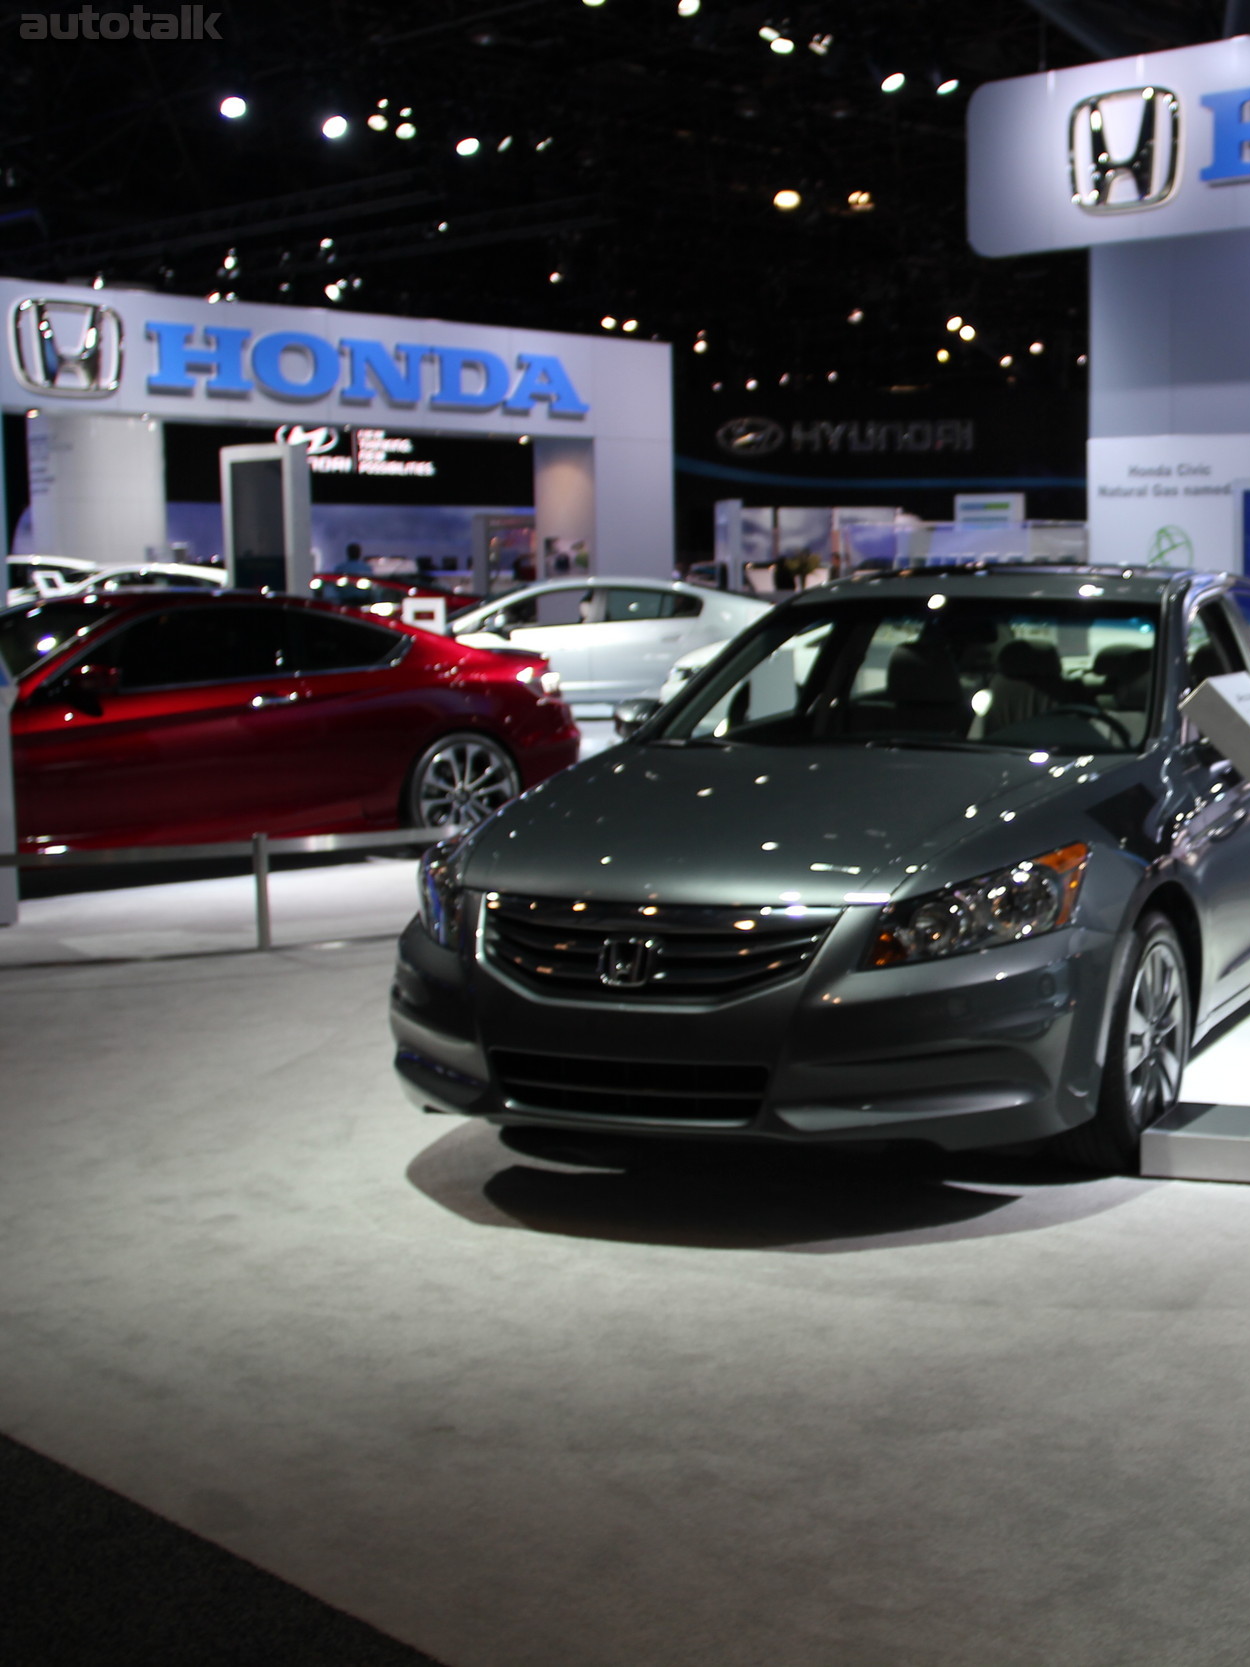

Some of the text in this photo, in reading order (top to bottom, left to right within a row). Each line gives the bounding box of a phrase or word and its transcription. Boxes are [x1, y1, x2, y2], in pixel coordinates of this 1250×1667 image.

[145, 320, 591, 420] HONDA
[792, 419, 975, 453] HYUNDAI
[1128, 463, 1211, 477] Honda Civic
[1099, 485, 1148, 497] Natural
[1153, 484, 1178, 496] Gas
